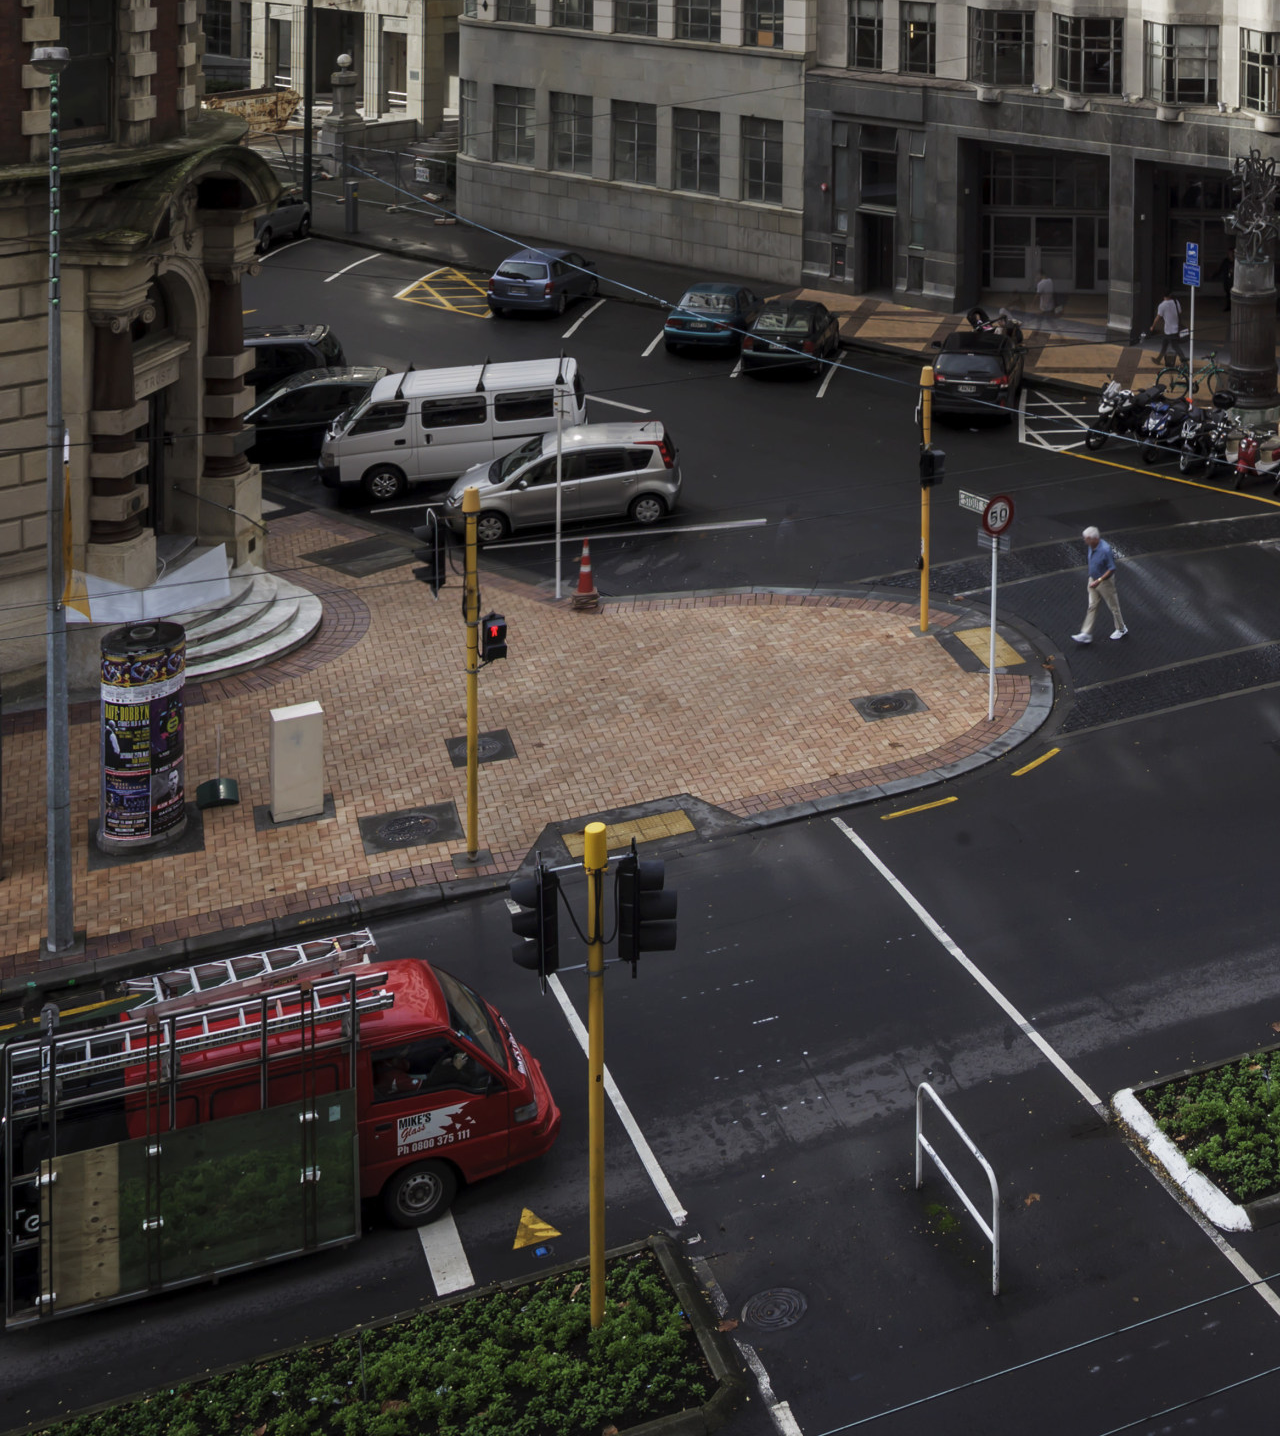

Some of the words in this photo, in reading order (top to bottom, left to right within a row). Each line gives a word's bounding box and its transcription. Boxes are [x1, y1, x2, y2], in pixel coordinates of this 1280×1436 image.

[144, 368, 172, 389] TRUST
[964, 496, 980, 510] STOUT
[990, 508, 1008, 527] 50
[119, 705, 150, 721] DOBBYN
[398, 1112, 431, 1130] MIKE'S
[401, 1124, 426, 1142] Glass
[397, 1145, 409, 1157] Ph
[411, 1138, 435, 1153] 0800
[436, 1133, 455, 1146] 375
[457, 1129, 471, 1141] 111
